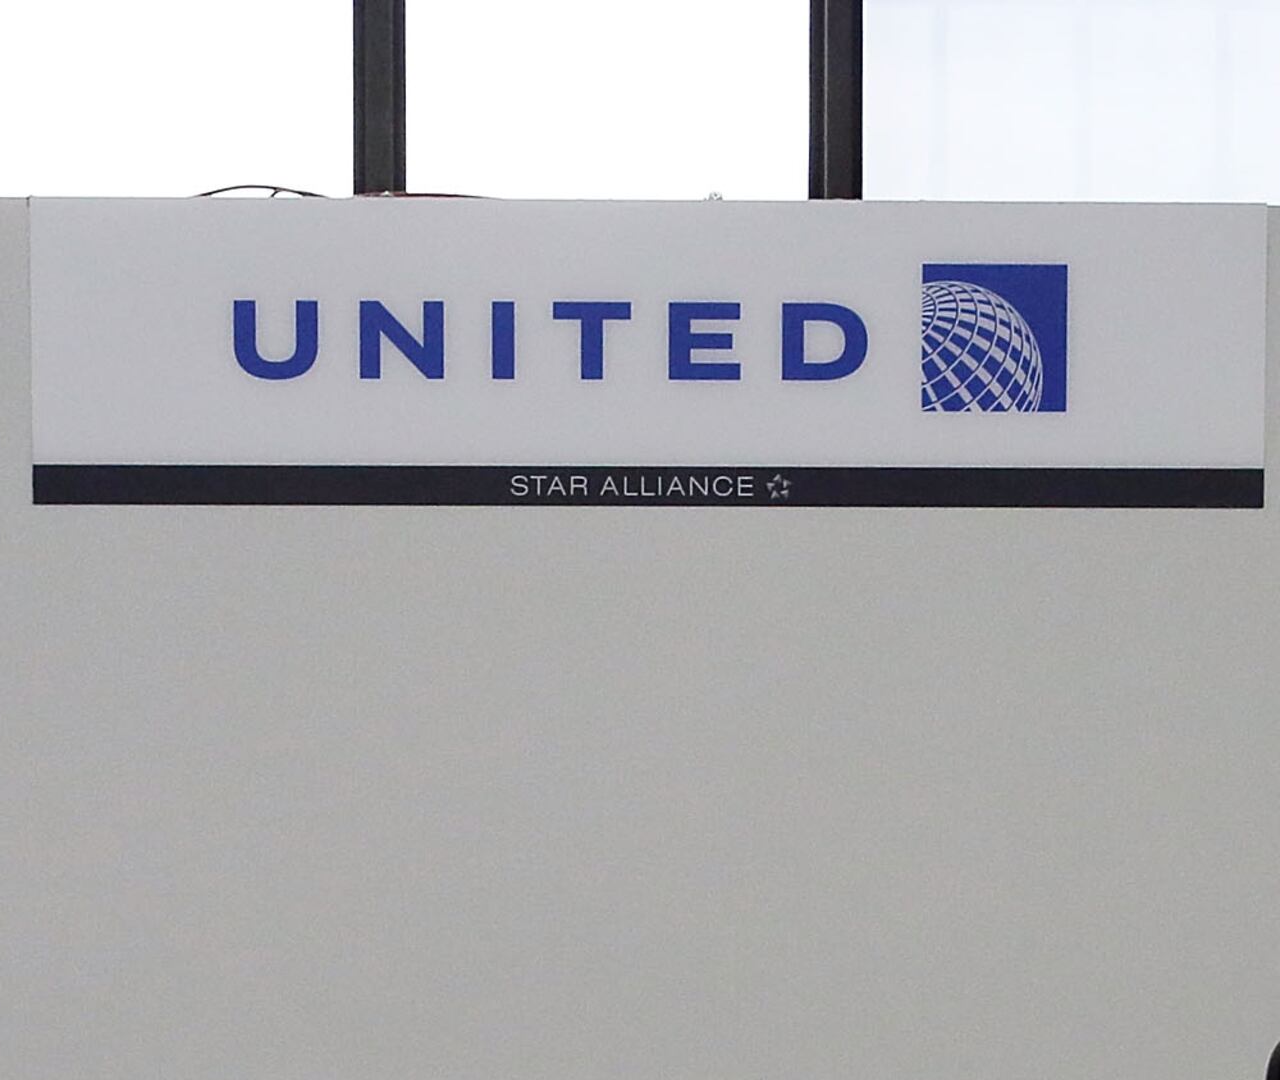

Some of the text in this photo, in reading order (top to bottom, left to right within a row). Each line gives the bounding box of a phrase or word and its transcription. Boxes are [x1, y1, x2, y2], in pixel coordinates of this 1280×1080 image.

[232, 299, 868, 381] UNITED
[510, 474, 754, 497] STAR ALLIANCE
